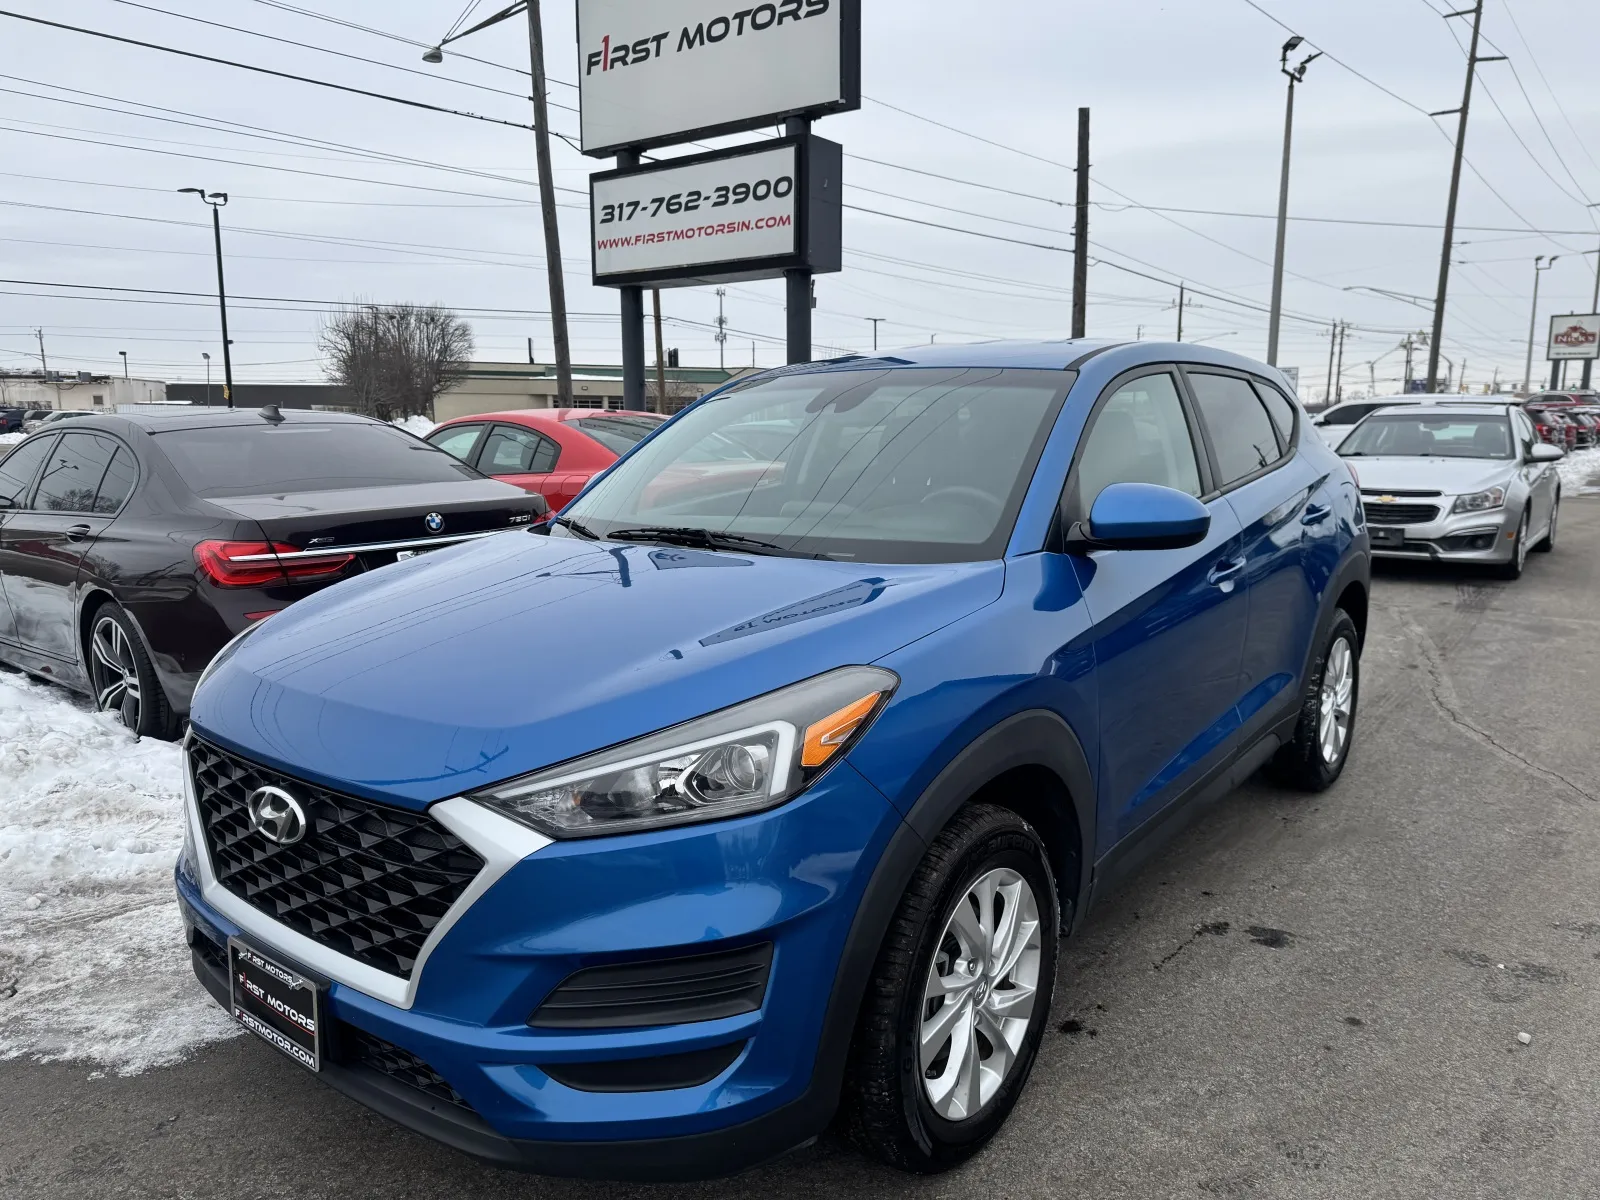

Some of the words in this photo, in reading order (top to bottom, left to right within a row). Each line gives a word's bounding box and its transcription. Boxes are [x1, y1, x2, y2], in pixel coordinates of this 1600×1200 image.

[676, 0, 829, 52] MOTORS
[599, 175, 793, 224] 317-762-3900
[597, 214, 791, 250] WWW.FIRSTMOTORSIN.COM
[265, 963, 293, 983] MOTORS
[267, 993, 315, 1031] MOTORS
